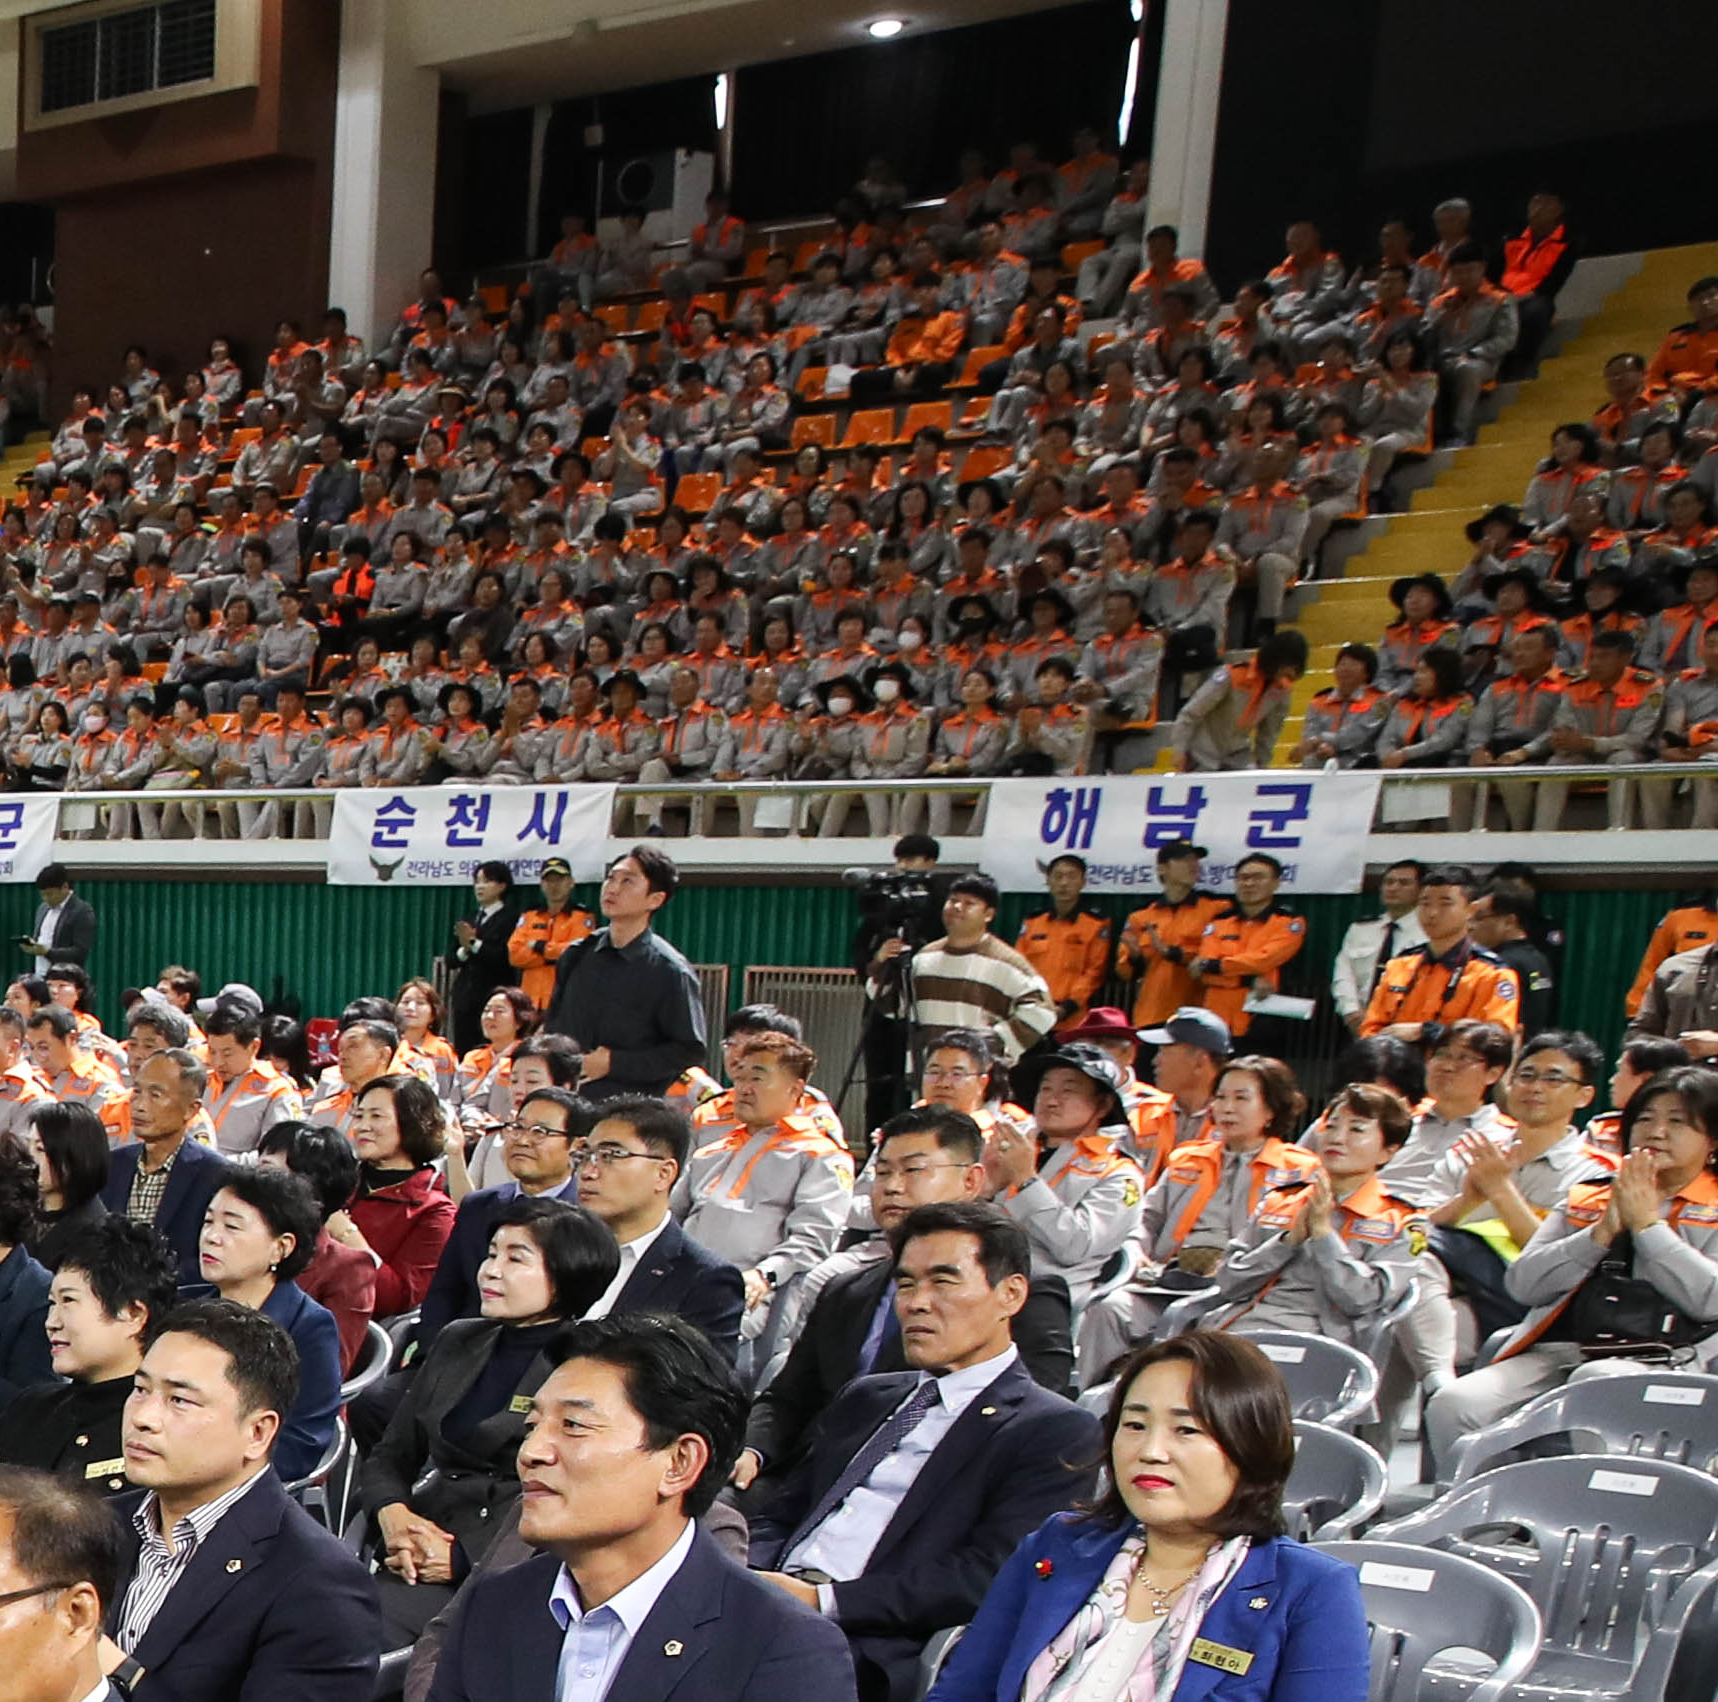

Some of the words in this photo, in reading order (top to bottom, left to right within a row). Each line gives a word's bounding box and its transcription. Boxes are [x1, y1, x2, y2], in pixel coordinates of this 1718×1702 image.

[371, 791, 569, 847] 순천시
[1040, 784, 1313, 849] 해남군
[406, 860, 454, 878] 전라남도
